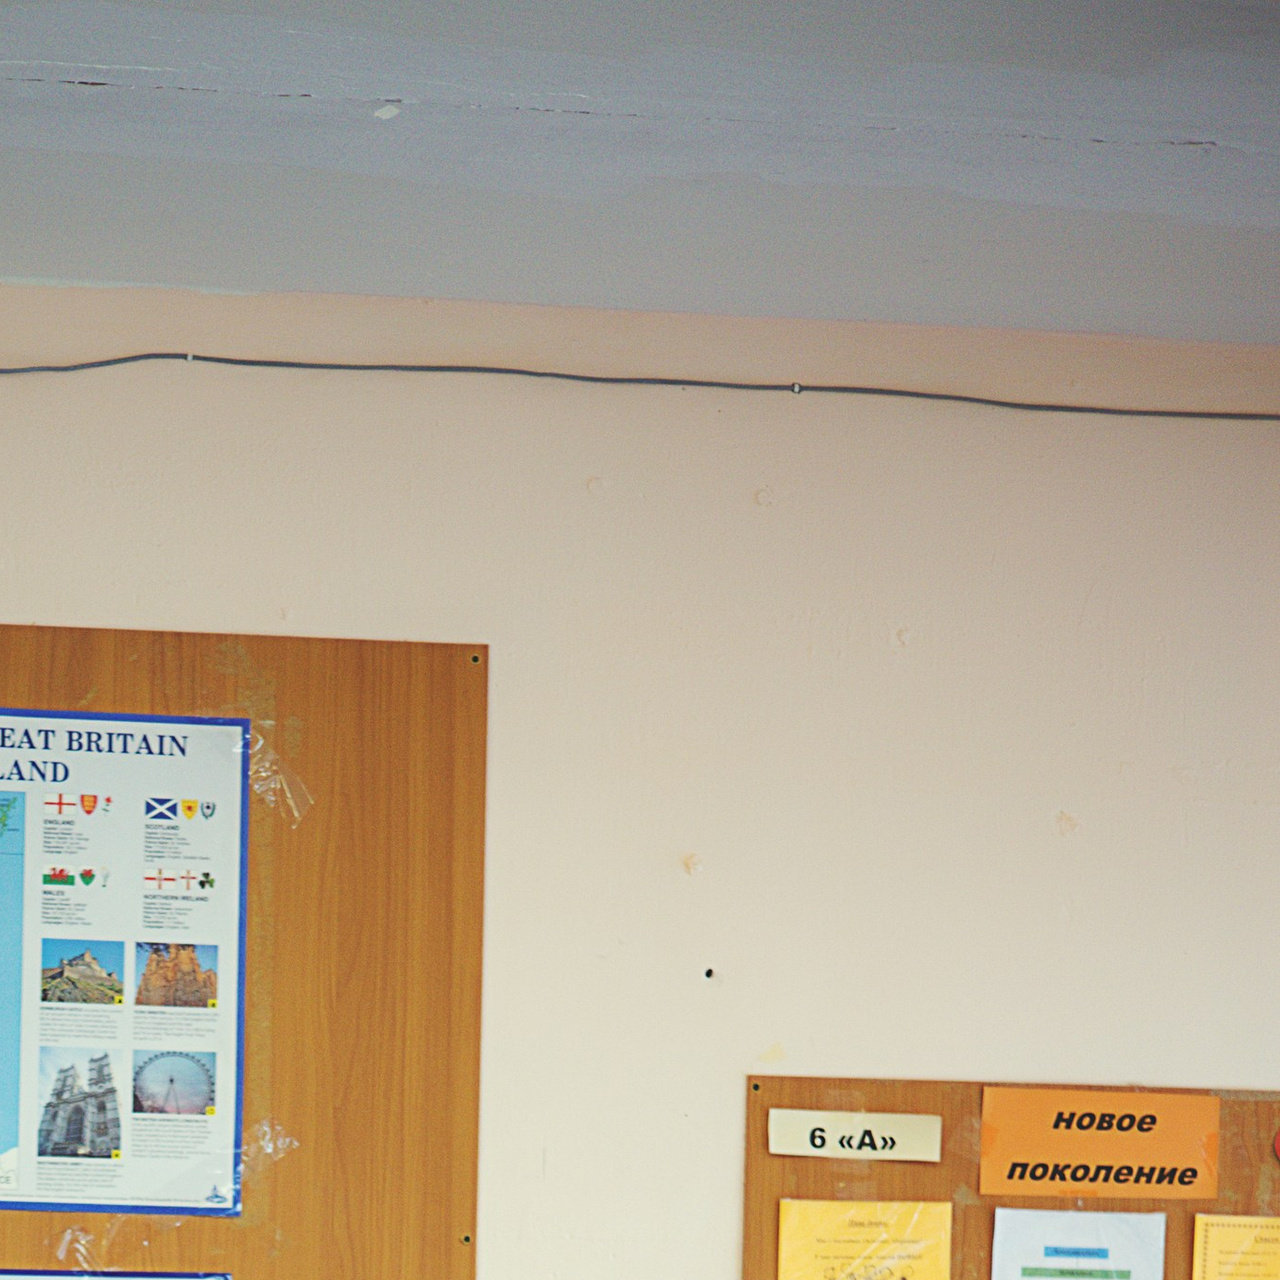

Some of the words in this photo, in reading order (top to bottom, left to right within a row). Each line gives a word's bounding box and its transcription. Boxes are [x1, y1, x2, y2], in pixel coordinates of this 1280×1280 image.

[65, 729, 189, 758] BRITAIN
[1052, 1111, 1157, 1133] новое
[809, 1127, 827, 1149] 6
[1006, 1161, 1199, 1186] поколение
